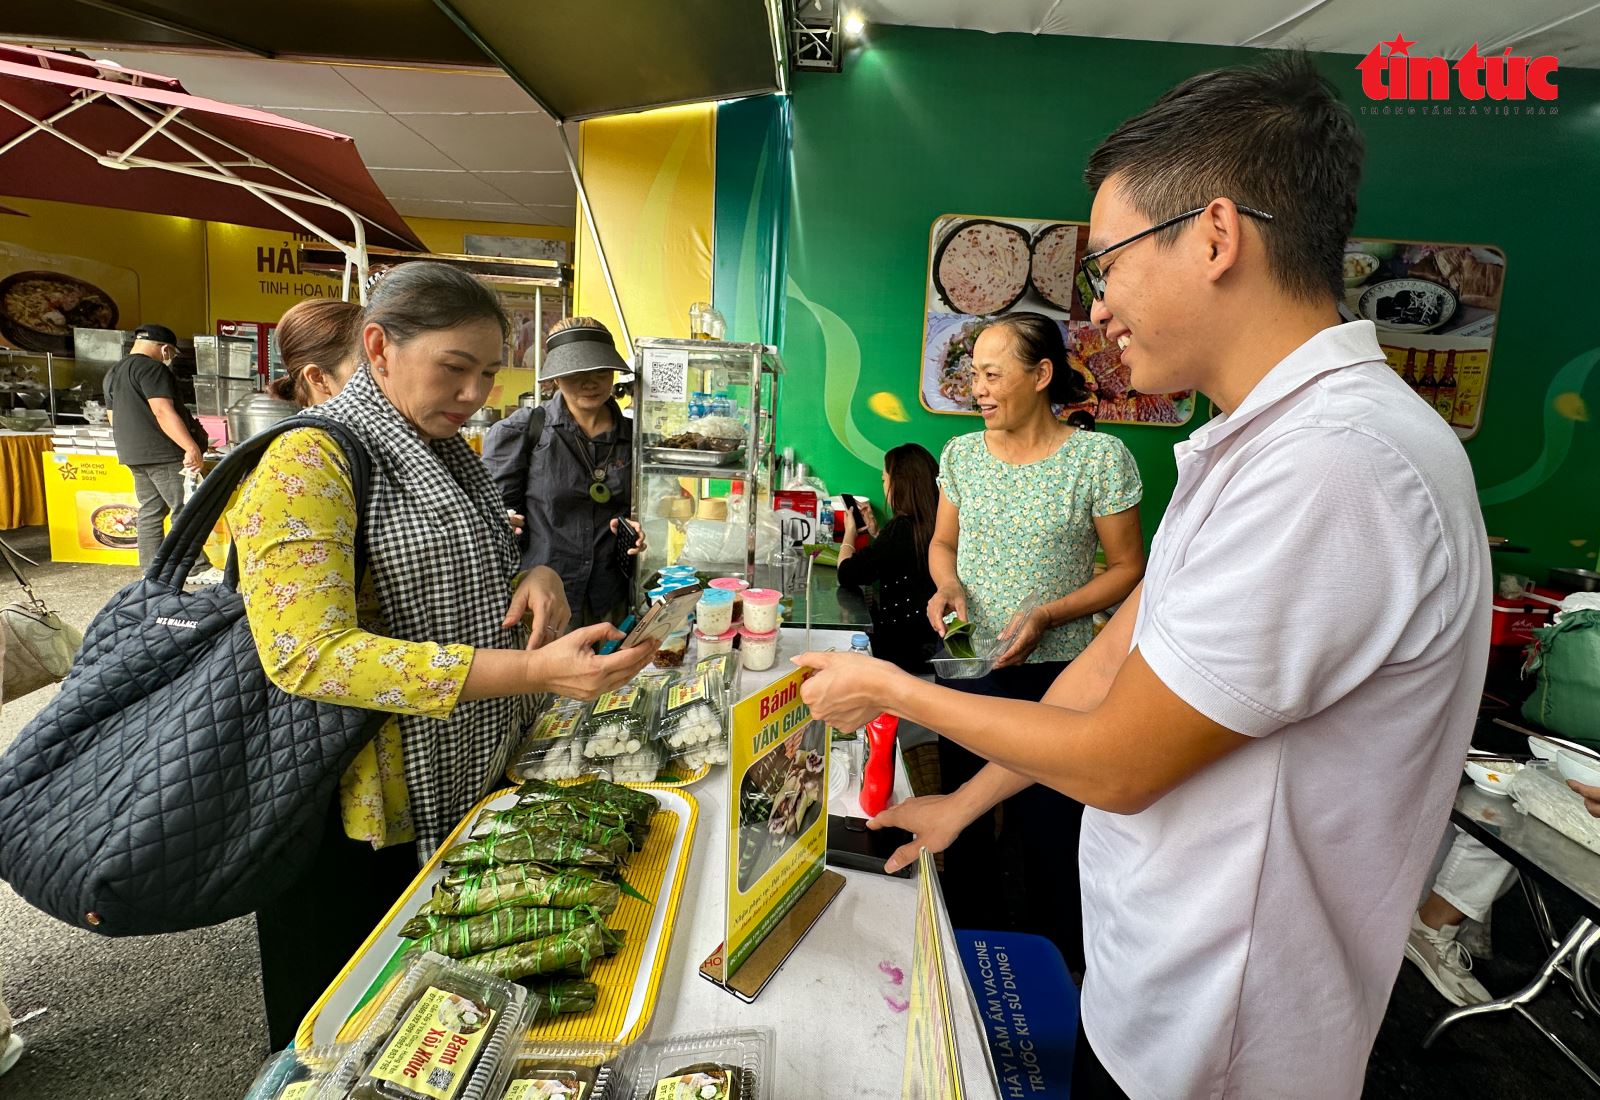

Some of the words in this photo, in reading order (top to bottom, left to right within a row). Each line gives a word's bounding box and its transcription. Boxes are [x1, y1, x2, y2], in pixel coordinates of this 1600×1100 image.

[258, 280, 289, 295] TINH
[294, 282, 324, 298] HOA
[760, 681, 797, 721] Bánh
[753, 721, 779, 755] VĂN
[974, 940, 999, 996] VACCINE
[996, 952, 1017, 991] DỤNG
[985, 1000, 1006, 1023] ẤM
[1002, 991, 1023, 1010] SỬ
[424, 1027, 447, 1048] Xôi
[1011, 1013, 1031, 1036] KHI
[439, 1033, 469, 1065] Bánh
[994, 1026, 1014, 1057] LÀM
[403, 1047, 434, 1079] Khúc
[1019, 1039, 1046, 1092] TRƯỚC
[1004, 1062, 1025, 1098] HÃY
